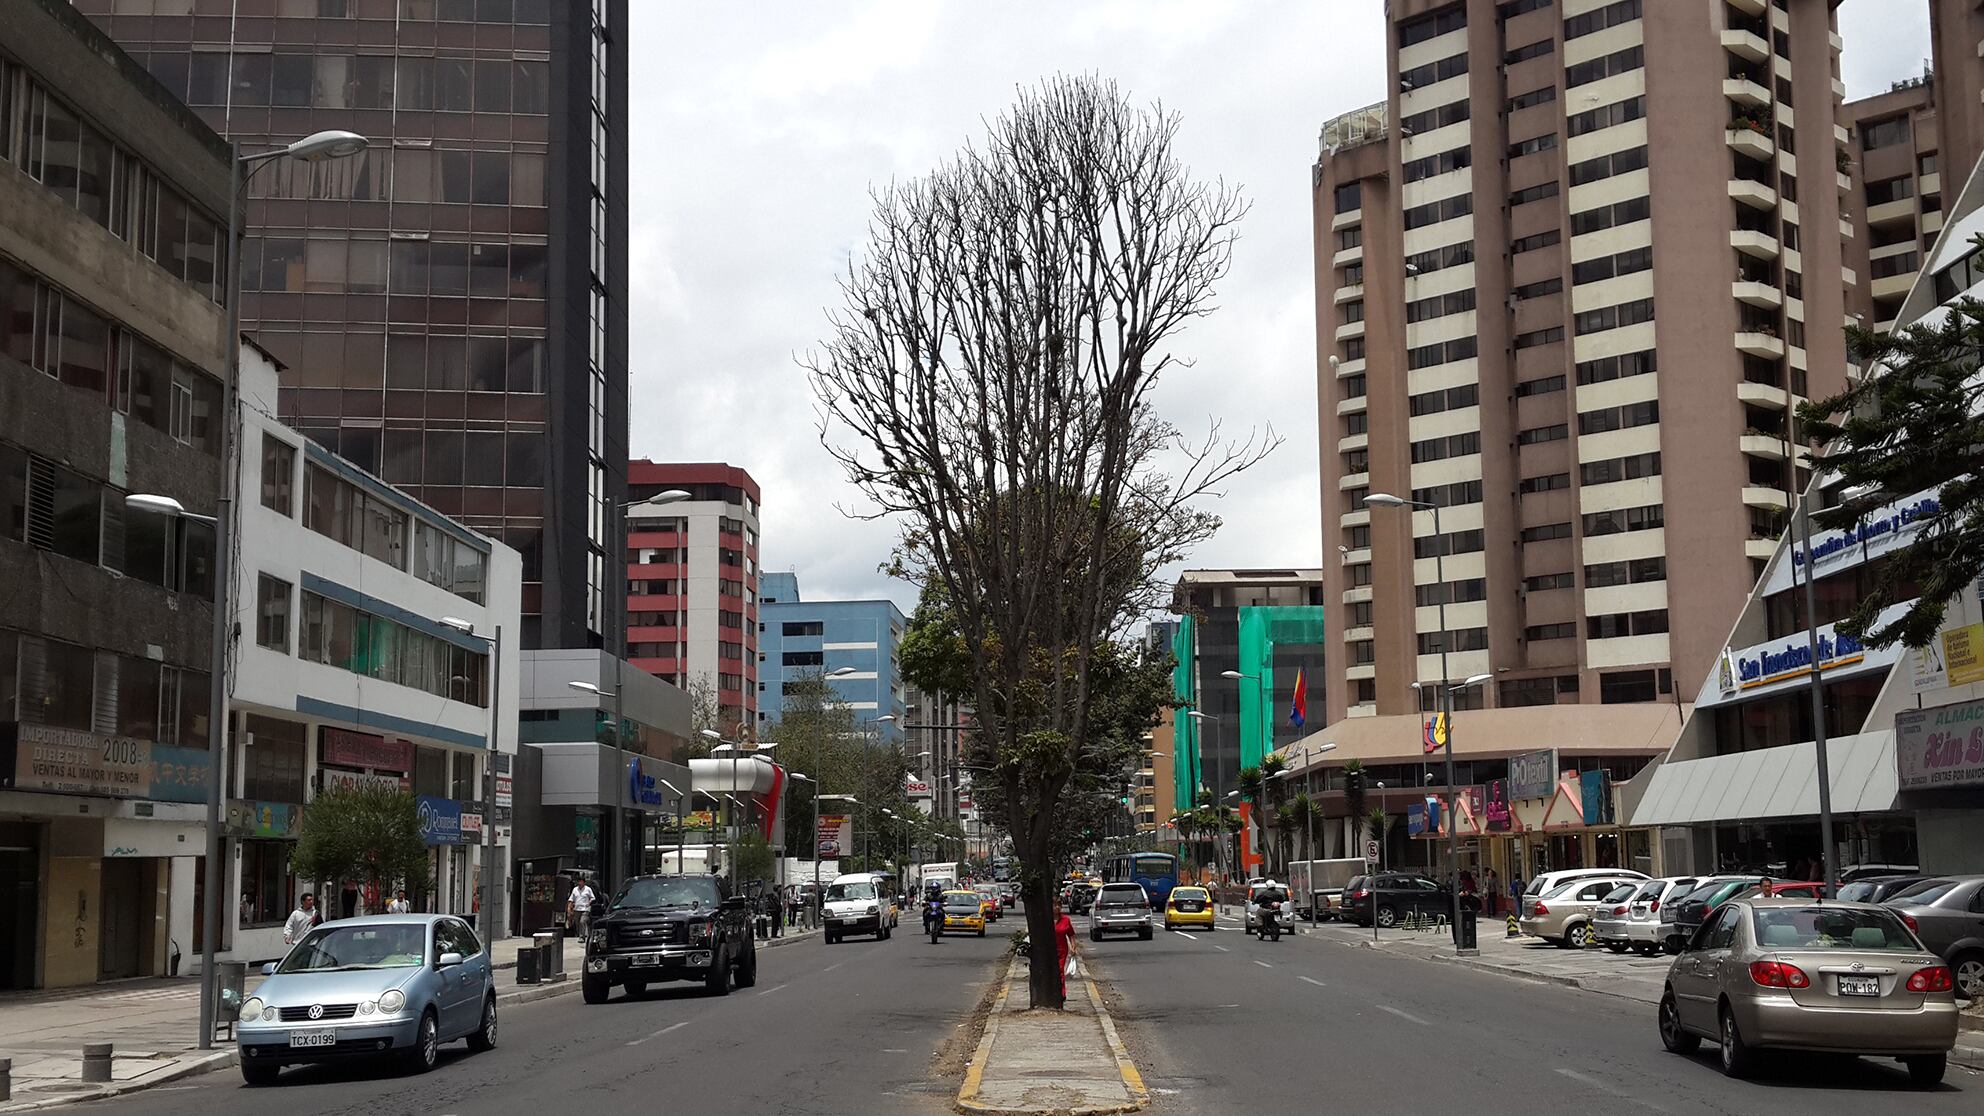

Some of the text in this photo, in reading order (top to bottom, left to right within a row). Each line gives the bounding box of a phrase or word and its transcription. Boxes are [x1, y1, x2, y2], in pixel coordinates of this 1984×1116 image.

[1891, 514, 1900, 534] y
[1739, 656, 1761, 682] San
[1935, 705, 1984, 726] ALMAC
[20, 725, 137, 765] IMPORTADORA 2008
[33, 745, 89, 766] DIRECTA
[1924, 726, 1984, 769] Xin S
[32, 762, 139, 785] VENTAS AL MAYOR Y MENOR
[1931, 770, 1952, 784] VENTAS
[1953, 768, 1965, 781] POR
[907, 783, 927, 792] se
[292, 1034, 334, 1046] TCX-0199
